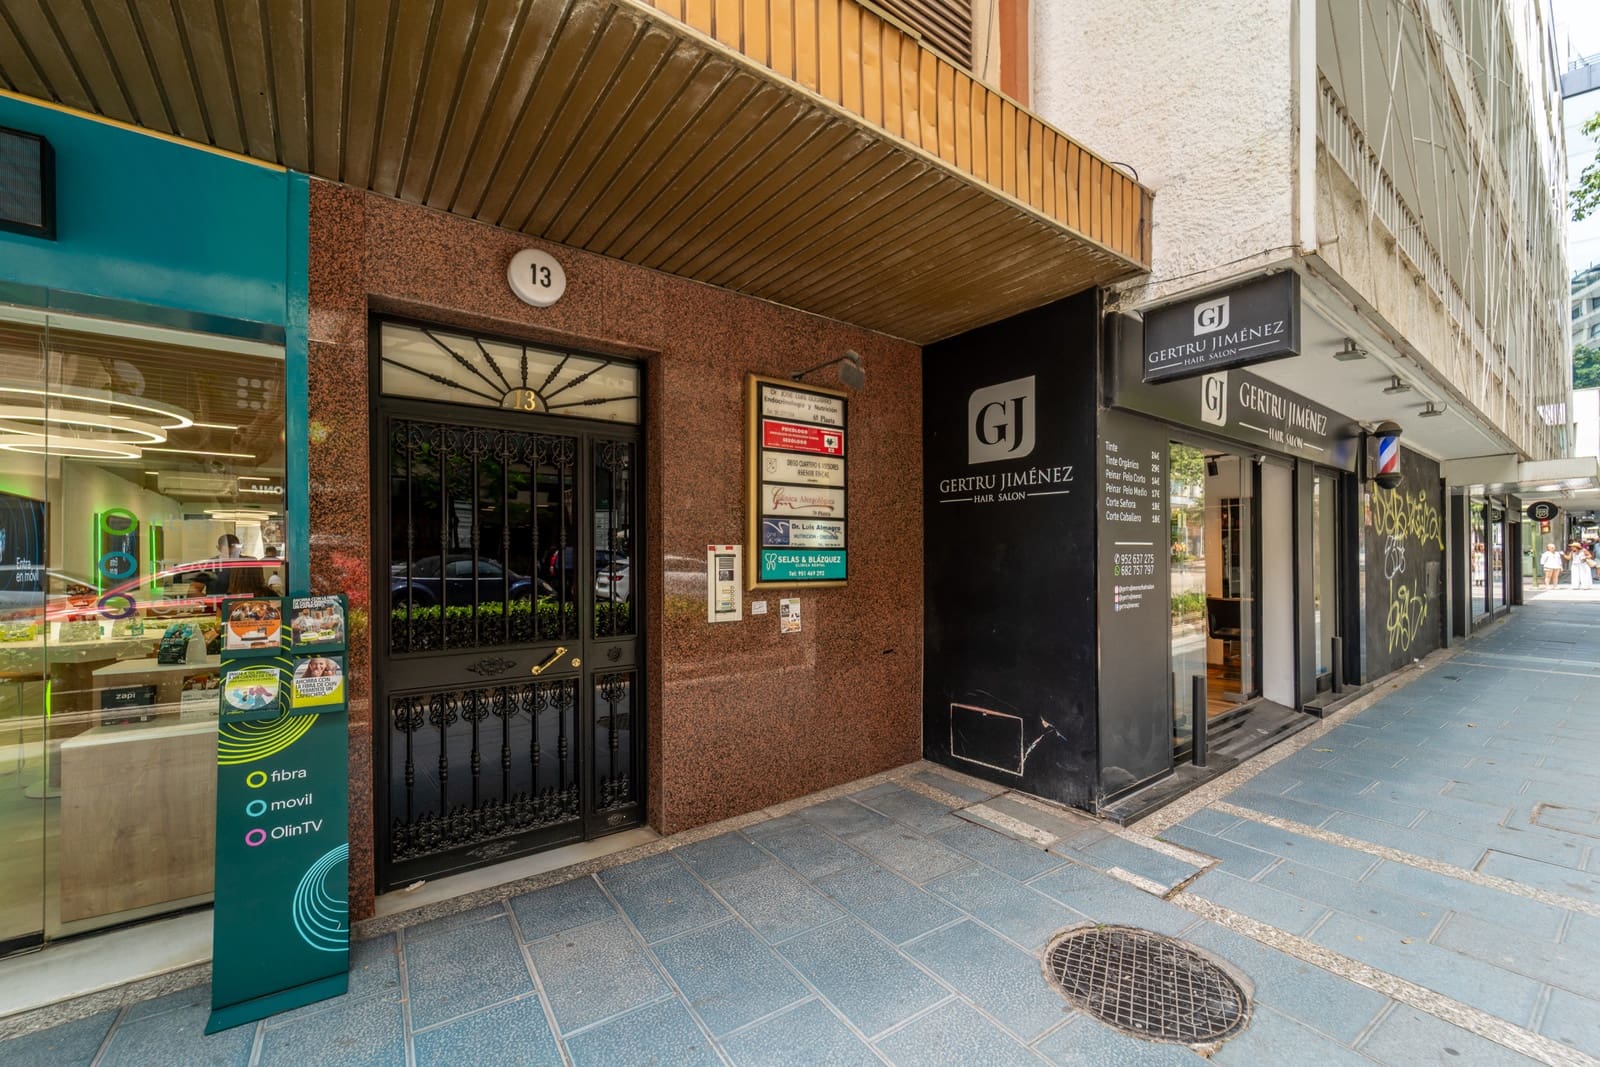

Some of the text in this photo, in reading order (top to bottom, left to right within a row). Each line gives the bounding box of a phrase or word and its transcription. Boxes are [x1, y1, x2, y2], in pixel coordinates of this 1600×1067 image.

[530, 263, 552, 288] 13
[1198, 303, 1225, 329] GJ
[1148, 320, 1285, 364] GERTRU JIMÉNEZ
[1184, 348, 1237, 366] HAIR SALON
[513, 389, 536, 411] 13
[1205, 376, 1225, 421] GJ
[1239, 382, 1328, 437] GERTRU JIMÉNEZ
[975, 395, 1028, 453] GJ
[1105, 441, 1118, 452] Tinte
[1268, 427, 1304, 449] HAIR SALON
[1105, 454, 1118, 466] Tinte
[940, 465, 1074, 494] GERTRU JIMÉNEZ
[1122, 471, 1133, 482] Pelo
[974, 491, 1026, 504] HAIR SALON
[1122, 485, 1133, 495] Pelo
[816, 524, 841, 532] Almagro
[777, 554, 841, 564] SELAS & BLÁZQUEZ
[1120, 553, 1132, 564] 952
[1144, 553, 1155, 564] 275
[1120, 565, 1132, 576] 682
[1144, 564, 1155, 575] 797
[271, 769, 307, 783] fibra
[271, 793, 313, 811] movil
[271, 819, 323, 839] OlinTV
